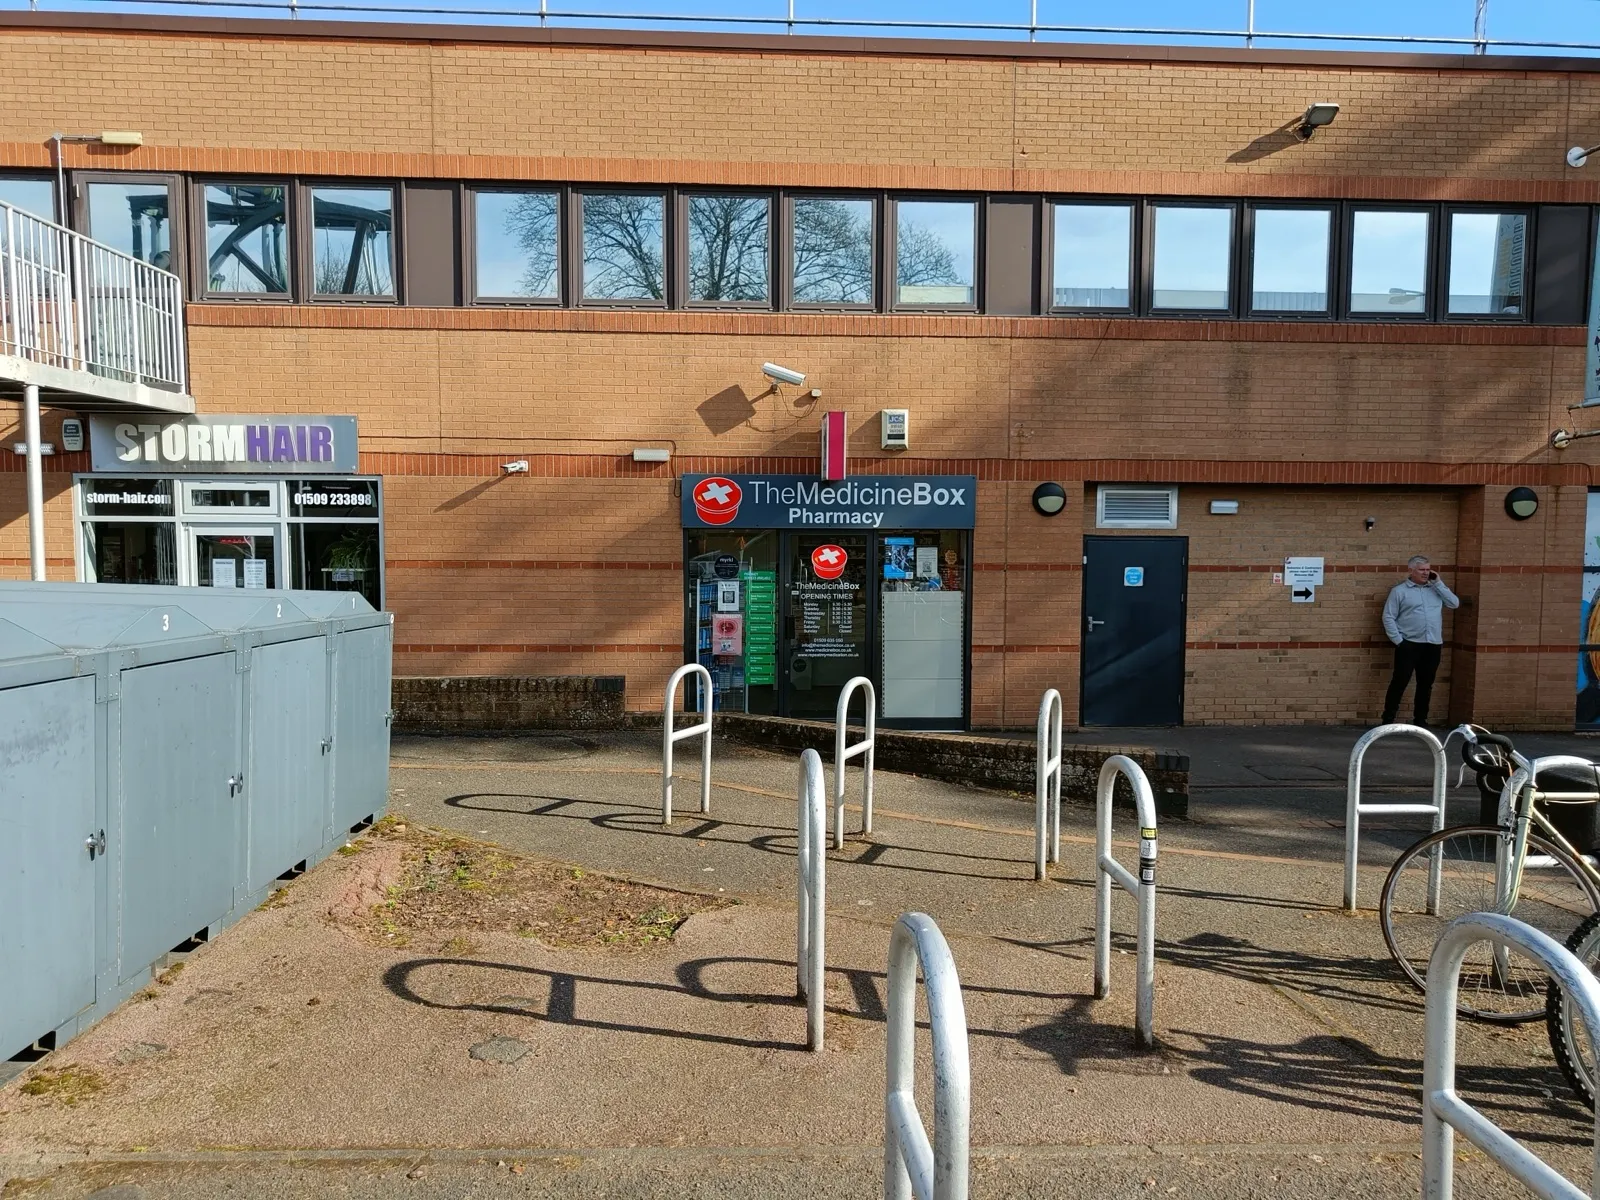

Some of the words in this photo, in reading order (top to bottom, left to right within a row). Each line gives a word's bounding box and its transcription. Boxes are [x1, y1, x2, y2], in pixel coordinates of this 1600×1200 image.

[115, 423, 334, 462] STORMHAIR
[86, 492, 172, 505] storm-hair.com
[294, 493, 328, 505] 01509
[330, 493, 372, 505] 233898
[749, 481, 966, 506] TheMedicineBox
[788, 508, 884, 528] Pharmacy
[276, 604, 282, 618] 2
[351, 598, 356, 609] 1
[162, 614, 169, 631] 3
